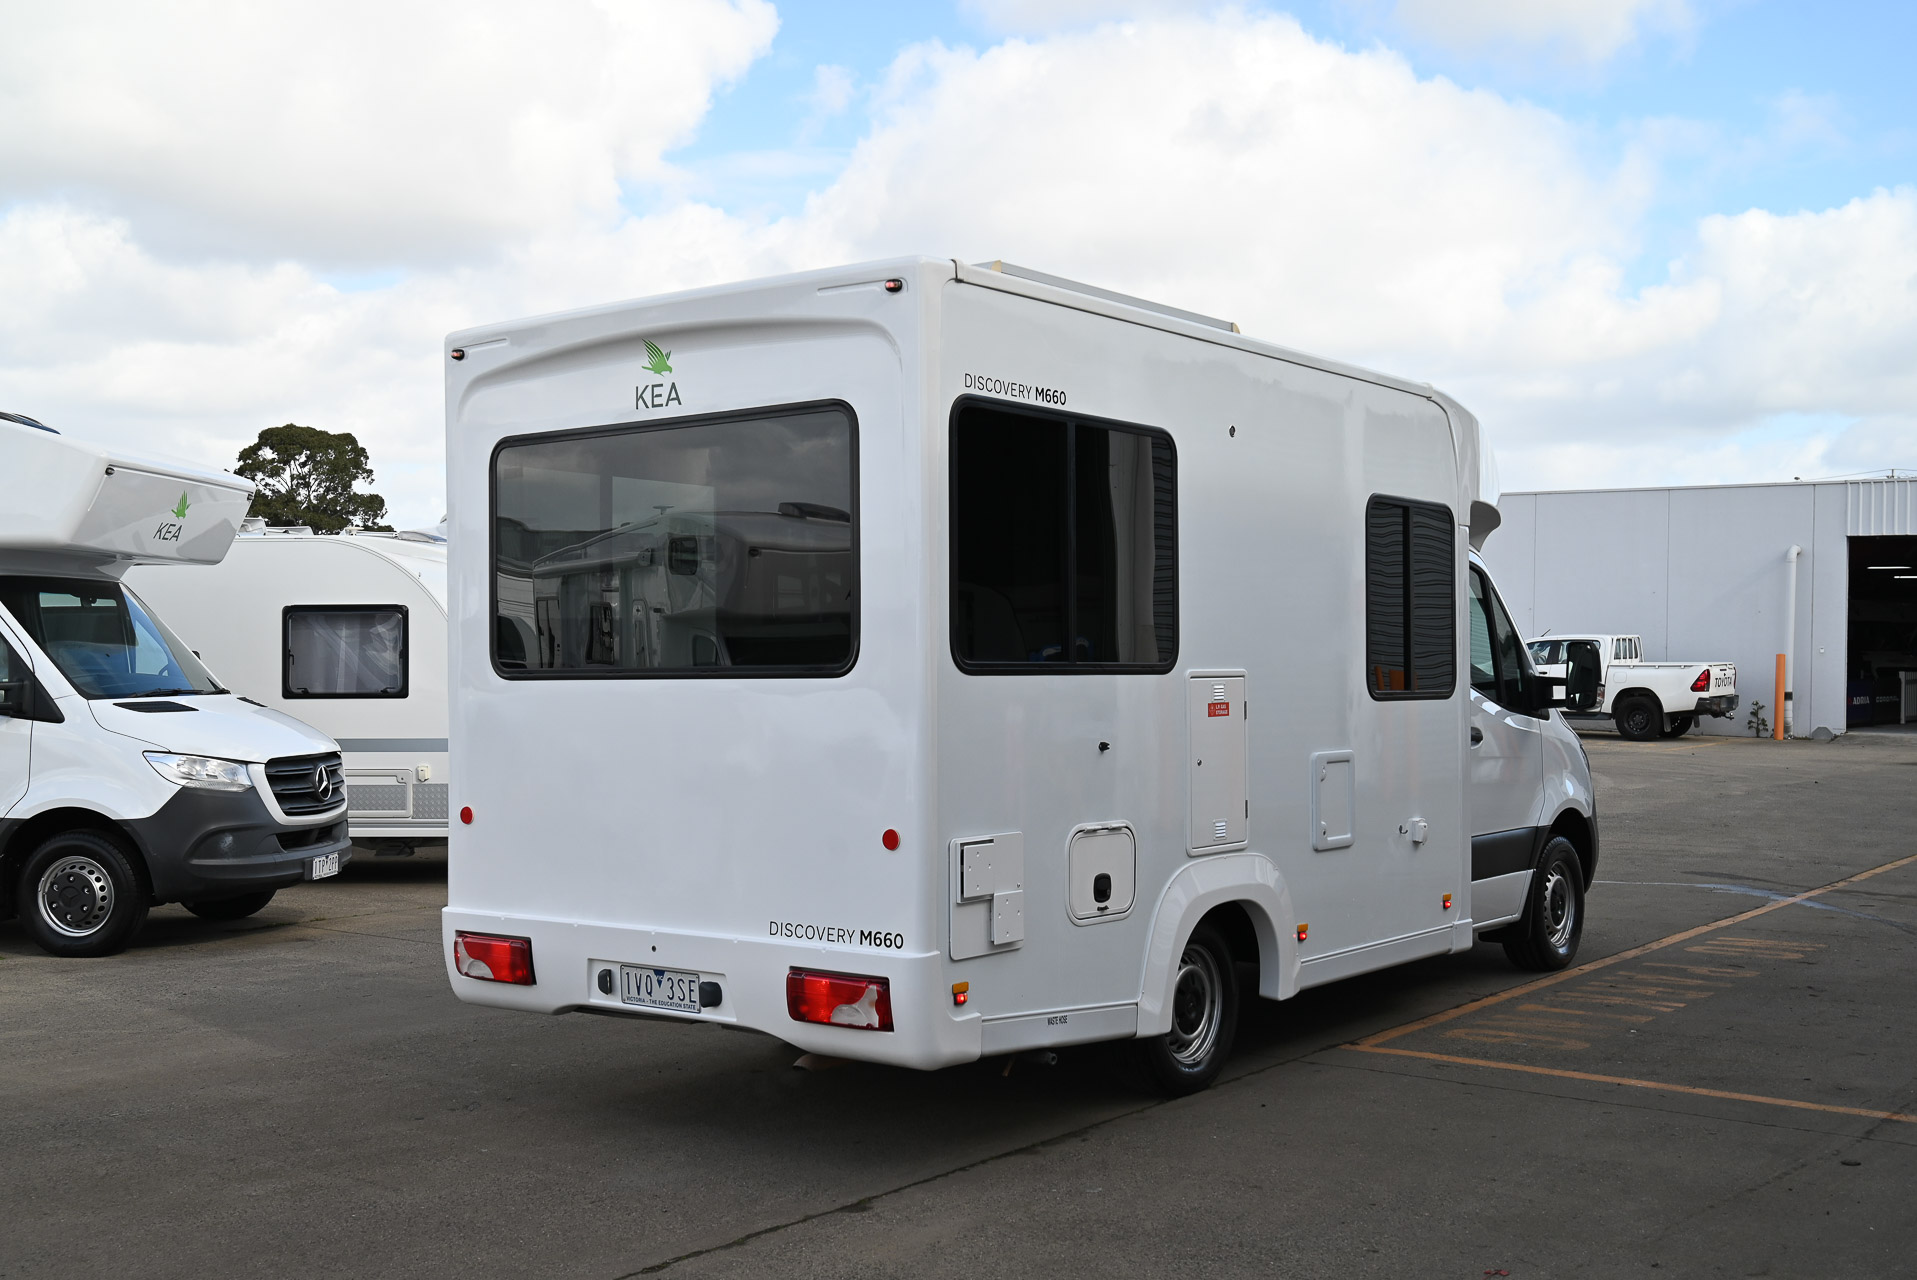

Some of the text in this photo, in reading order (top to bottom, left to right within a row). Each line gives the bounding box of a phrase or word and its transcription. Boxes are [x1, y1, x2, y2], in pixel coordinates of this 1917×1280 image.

[635, 382, 682, 410] KEA
[964, 373, 1067, 406] DISCOVERY M660
[153, 522, 182, 542] KEA
[1714, 676, 1732, 688] TOYOTA
[1853, 696, 1870, 705] ADRIA
[769, 920, 904, 949] DISCOVERY M660
[626, 971, 697, 1004] 1VQ 3SE
[626, 996, 645, 1004] VICTORIA
[658, 1000, 682, 1009] EDUCATION
[1047, 1016, 1058, 1025] WASTE
